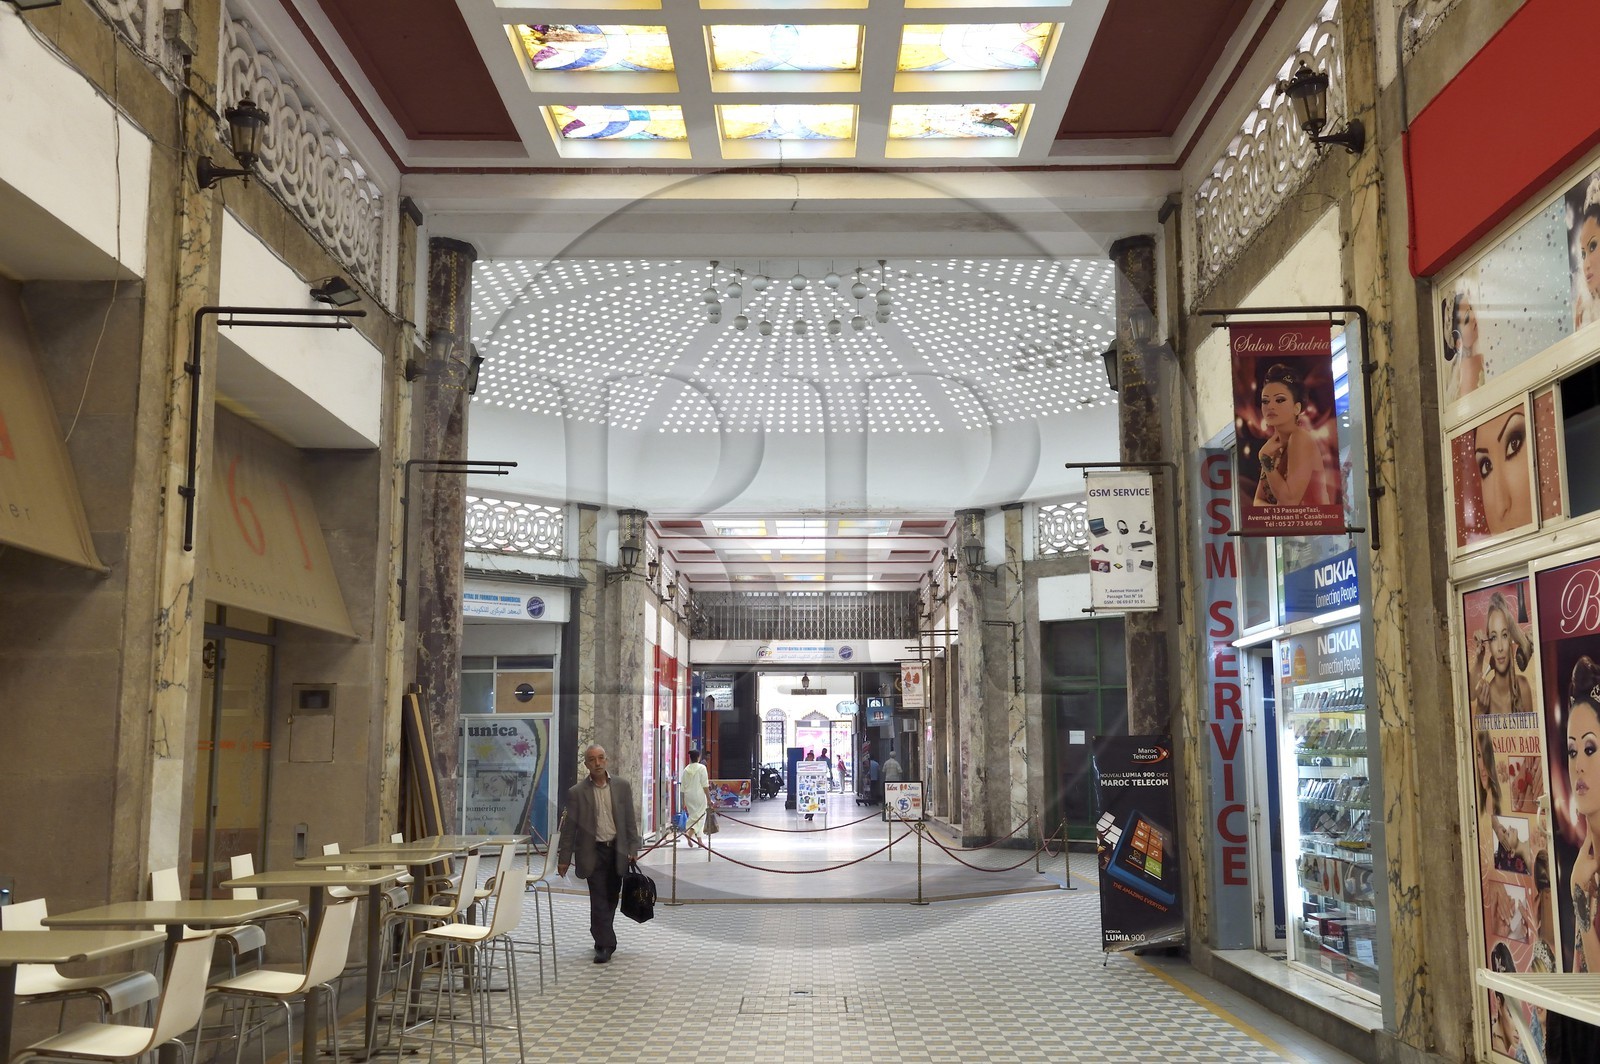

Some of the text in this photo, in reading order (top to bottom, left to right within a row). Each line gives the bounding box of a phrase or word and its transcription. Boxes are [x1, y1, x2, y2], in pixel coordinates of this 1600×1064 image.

[1233, 332, 1331, 355] Salon Badria
[1089, 488, 1150, 497] GSM SERVICE
[1200, 453, 1238, 580] GSM
[1271, 513, 1294, 521] Hassan
[1314, 557, 1357, 589] NOKIA
[1315, 582, 1358, 609] Connecting People
[1317, 628, 1360, 656] NOKIA
[1318, 658, 1344, 676] Connecting
[1343, 655, 1361, 673] People
[1474, 714, 1502, 731] COIFFURE
[1492, 736, 1517, 754] SALON
[1100, 779, 1130, 787] MAROC
[1128, 854, 1143, 865] Office
[1112, 881, 1169, 913] THE AMAZING EVERYDAY
